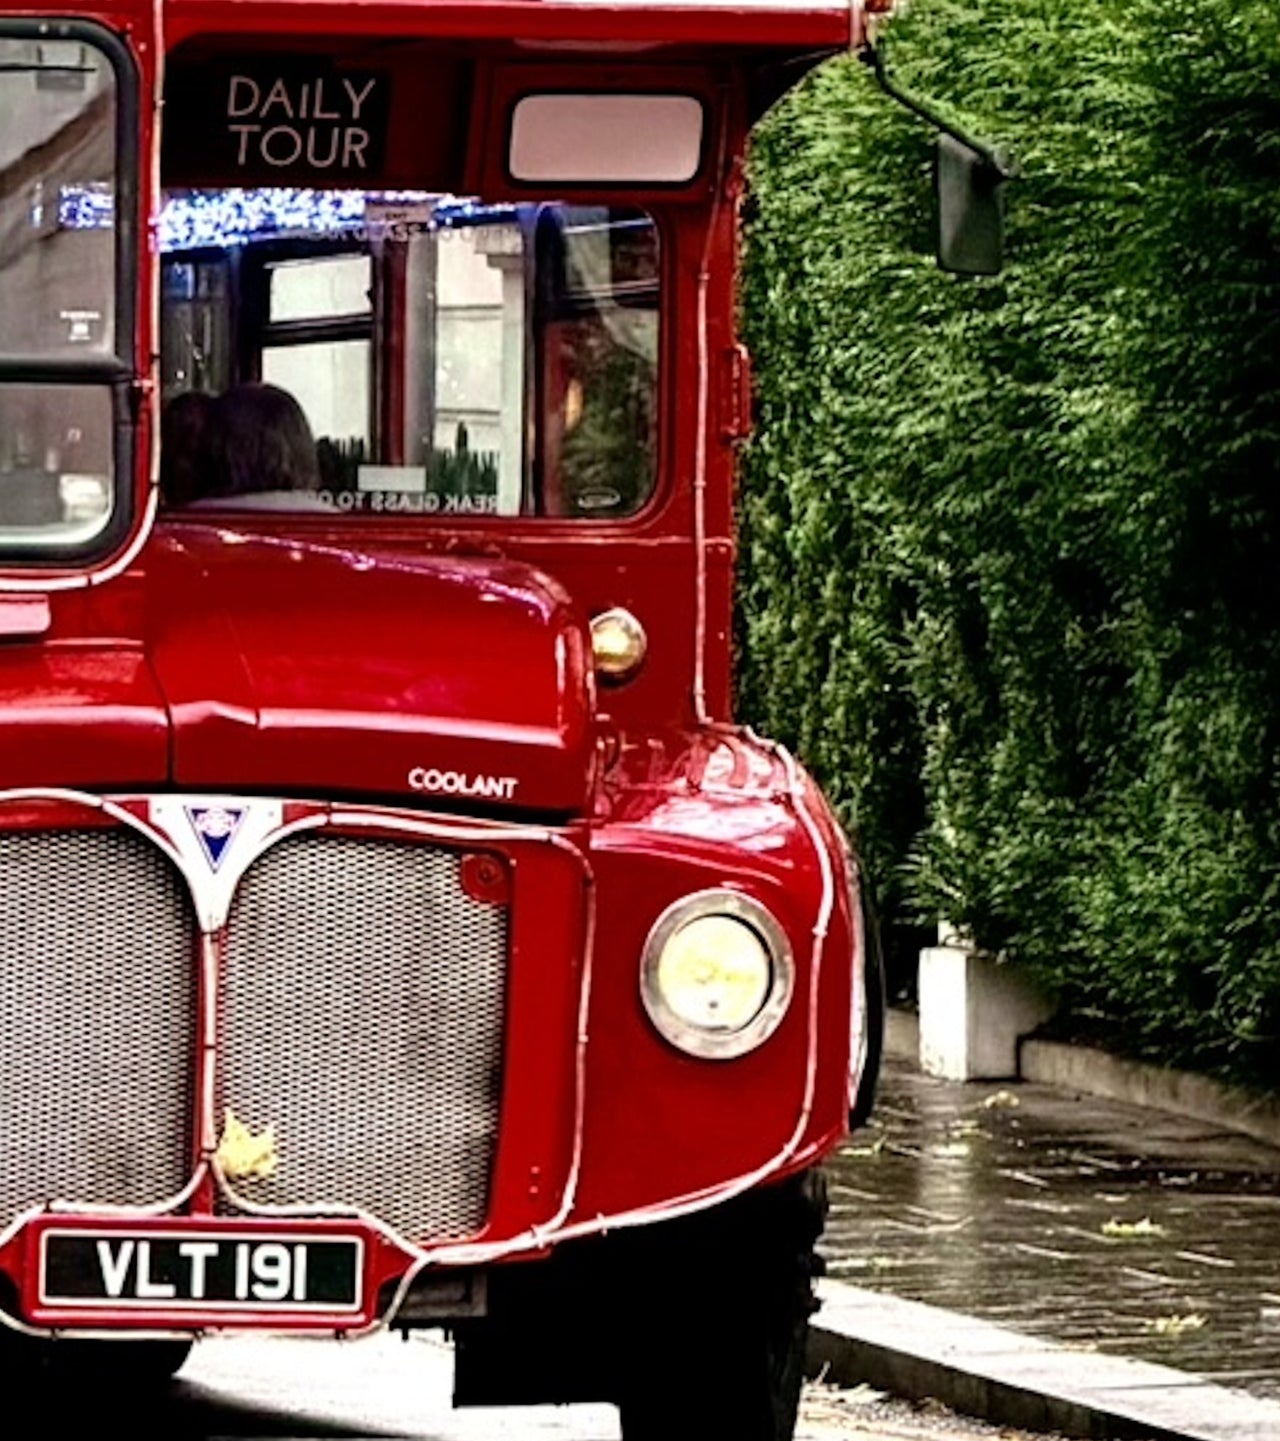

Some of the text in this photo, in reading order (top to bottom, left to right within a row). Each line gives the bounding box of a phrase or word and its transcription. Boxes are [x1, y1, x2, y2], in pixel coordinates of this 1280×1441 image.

[227, 74, 376, 119] DAILY
[227, 124, 371, 168] TOUR
[407, 767, 519, 799] COOLANT
[96, 1239, 308, 1301] VLT 191
